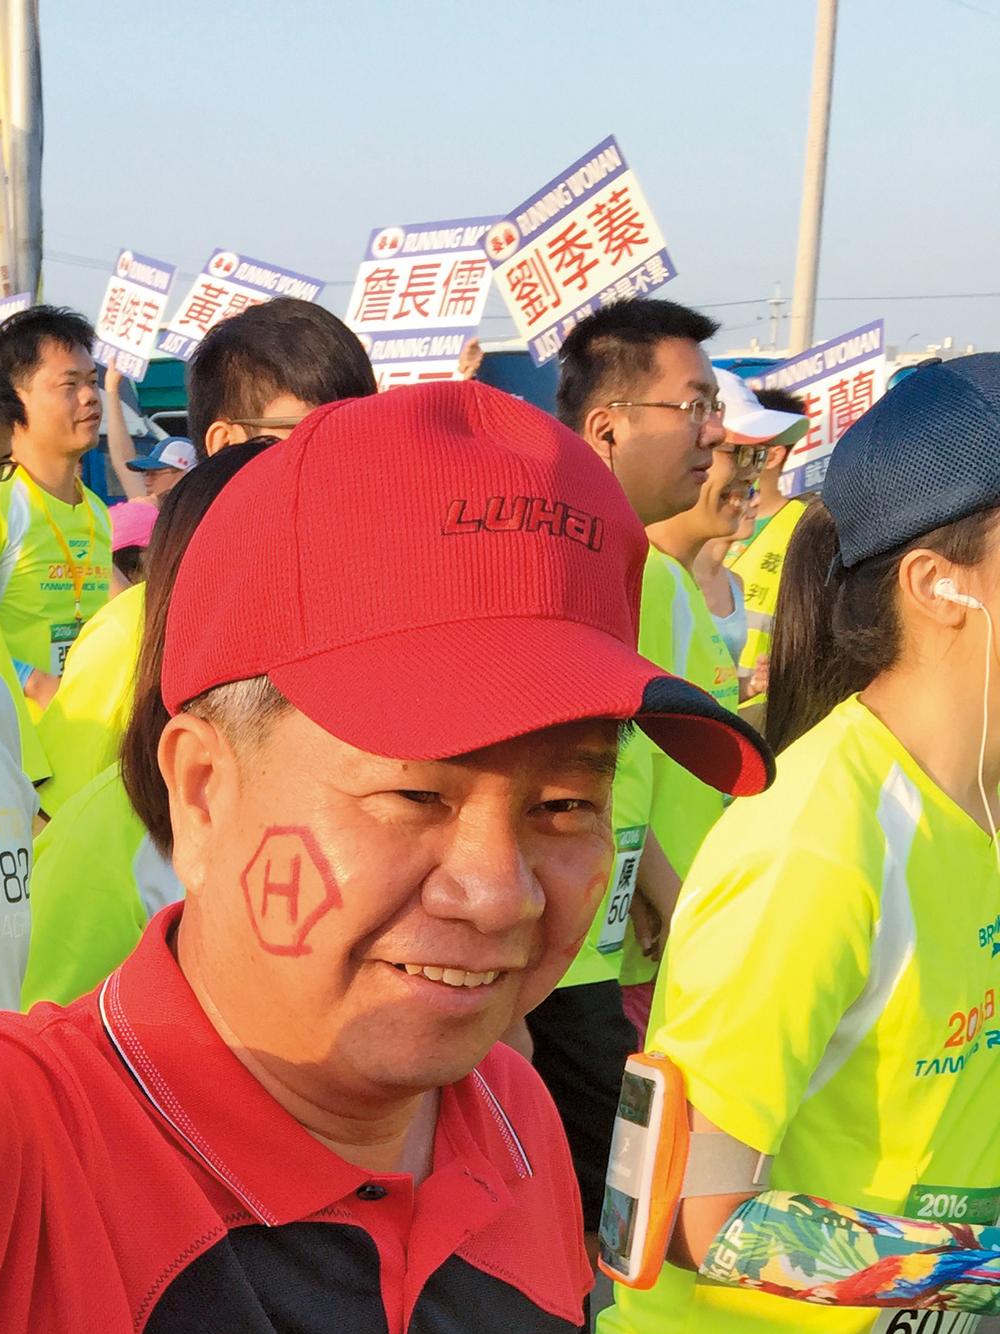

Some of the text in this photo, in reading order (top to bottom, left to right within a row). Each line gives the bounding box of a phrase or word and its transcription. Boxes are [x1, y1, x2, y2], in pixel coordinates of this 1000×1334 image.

[516, 145, 622, 237] RUNNING WOMAN
[402, 228, 462, 252] RUNNING
[506, 186, 649, 326] 劉季蓁
[233, 263, 278, 289] RUNNING
[272, 276, 319, 300] WOMAN
[354, 258, 489, 322] 詹長儒
[159, 332, 187, 351] JUST
[371, 335, 464, 360] RUNNING MAN
[825, 328, 880, 369] WOMAN
[917, 1193, 968, 1218] 2016
